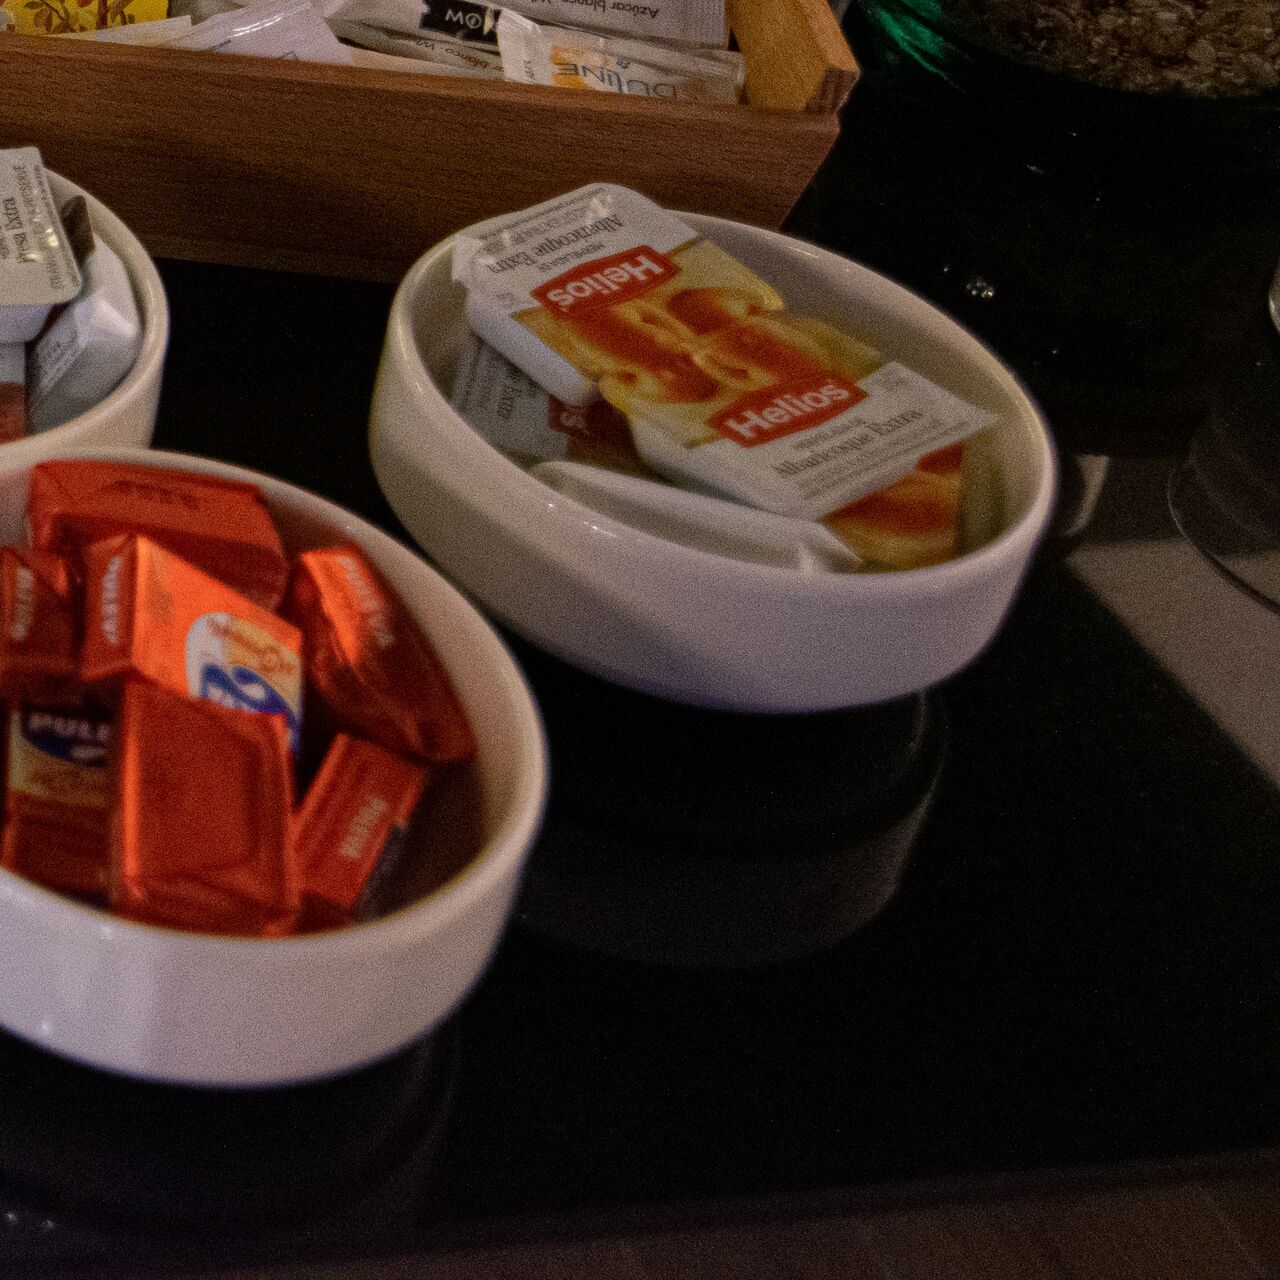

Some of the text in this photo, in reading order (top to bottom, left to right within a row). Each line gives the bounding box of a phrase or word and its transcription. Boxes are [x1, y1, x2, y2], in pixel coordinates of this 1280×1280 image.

[610, 1, 661, 20] Azúcar
[2, 197, 20, 229] Extra
[547, 254, 664, 307] Helios
[725, 383, 850, 439] Helios
